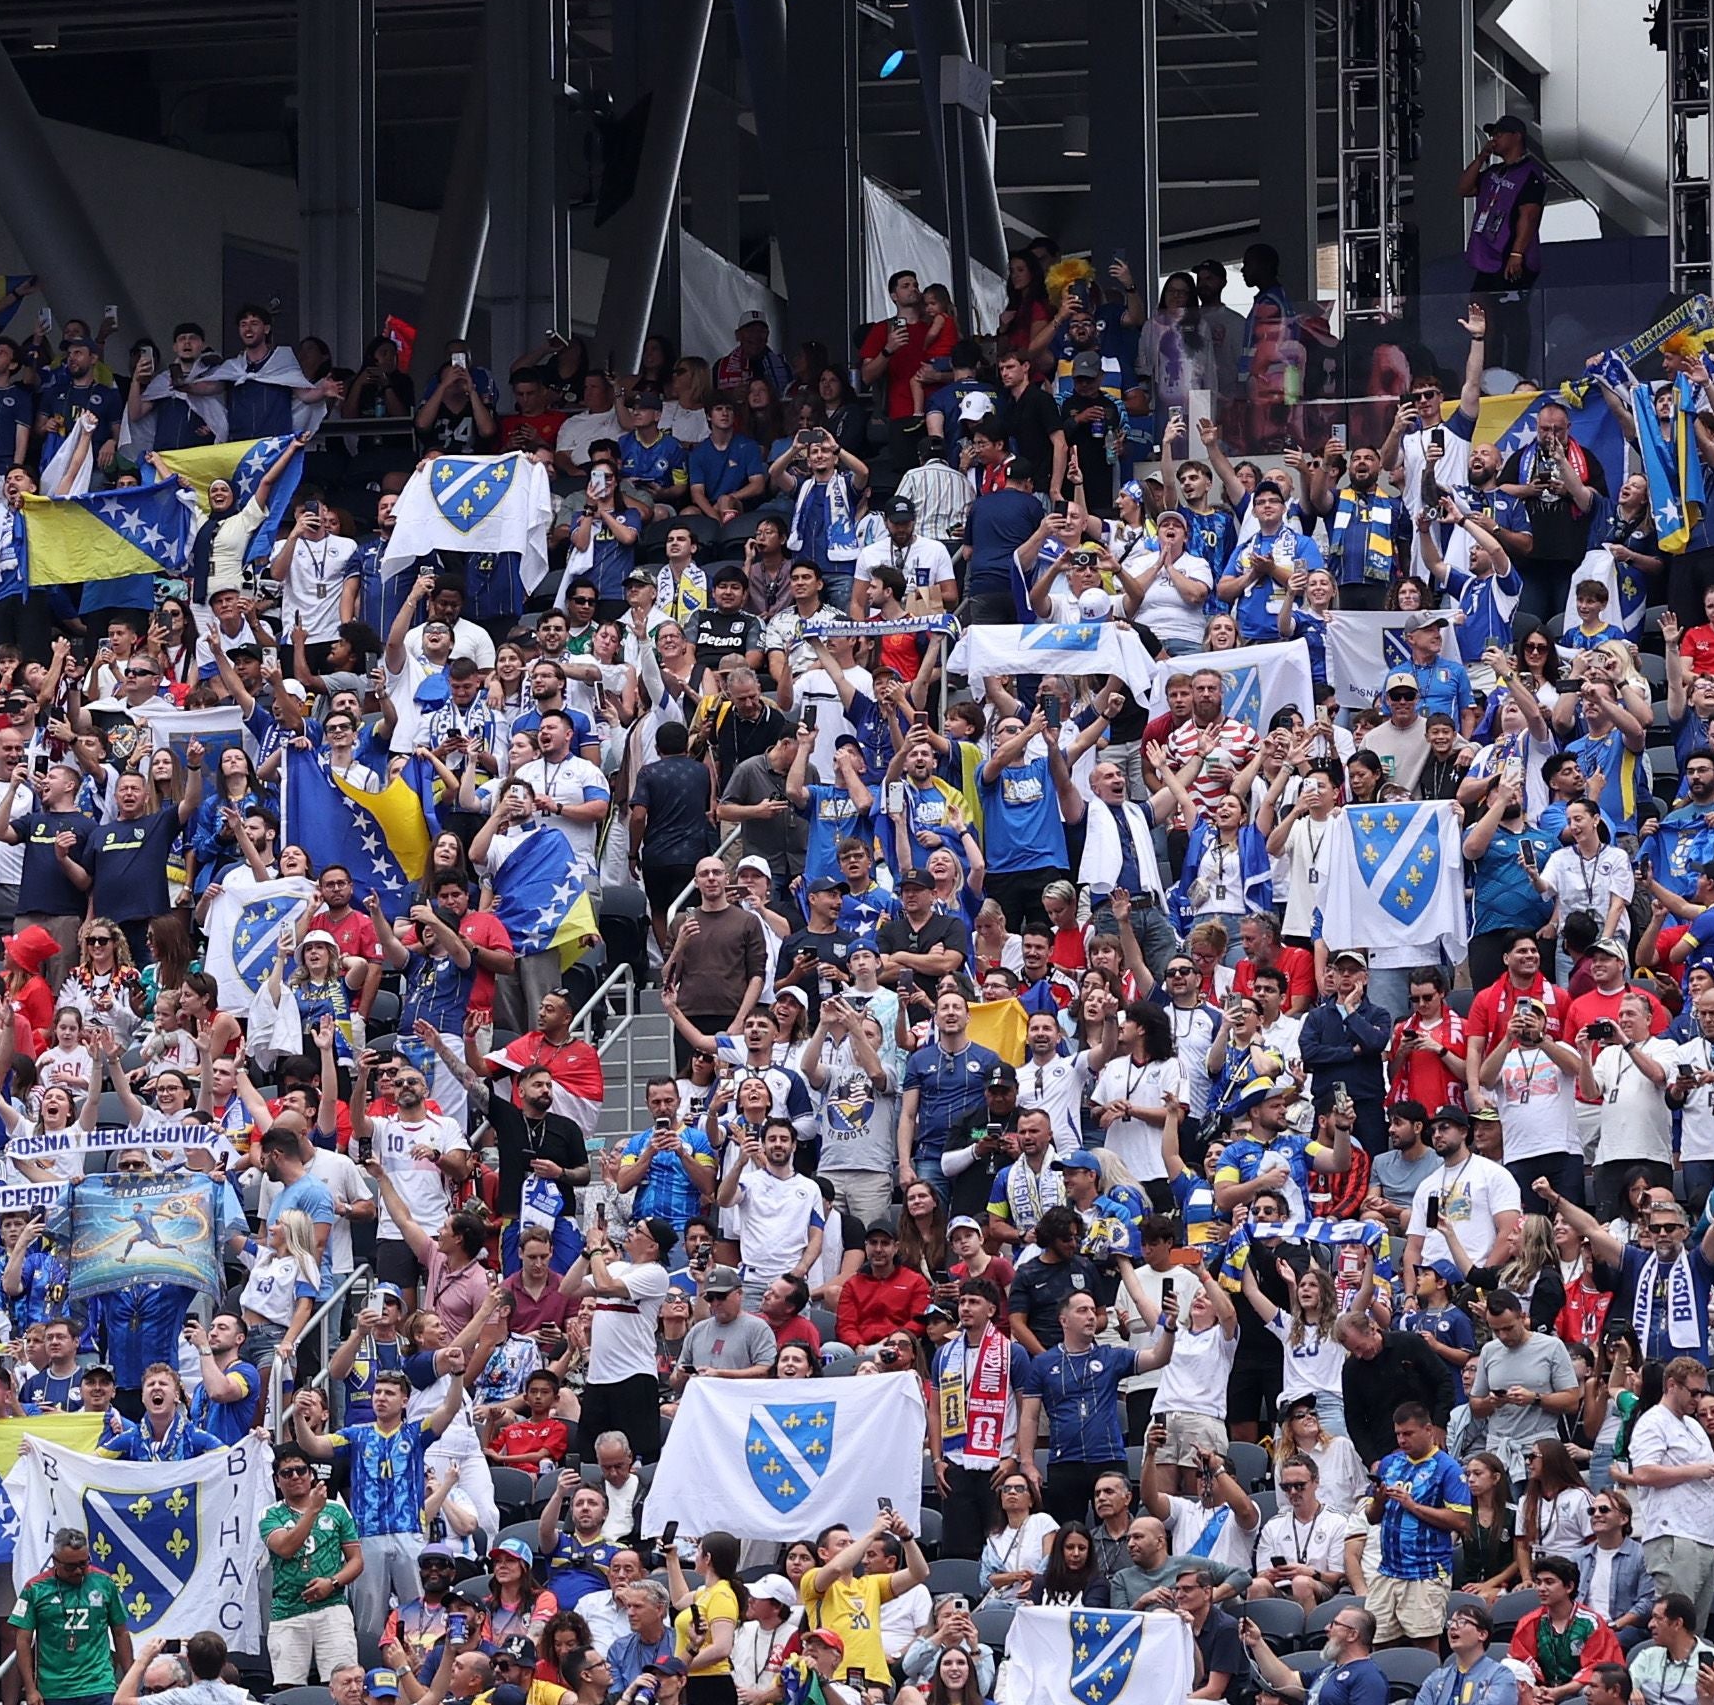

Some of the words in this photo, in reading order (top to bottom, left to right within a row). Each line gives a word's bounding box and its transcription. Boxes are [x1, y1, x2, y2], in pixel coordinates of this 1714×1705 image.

[1084, 607, 1095, 617] LA
[387, 1134, 404, 1153] 10
[64, 1609, 89, 1630] 22
